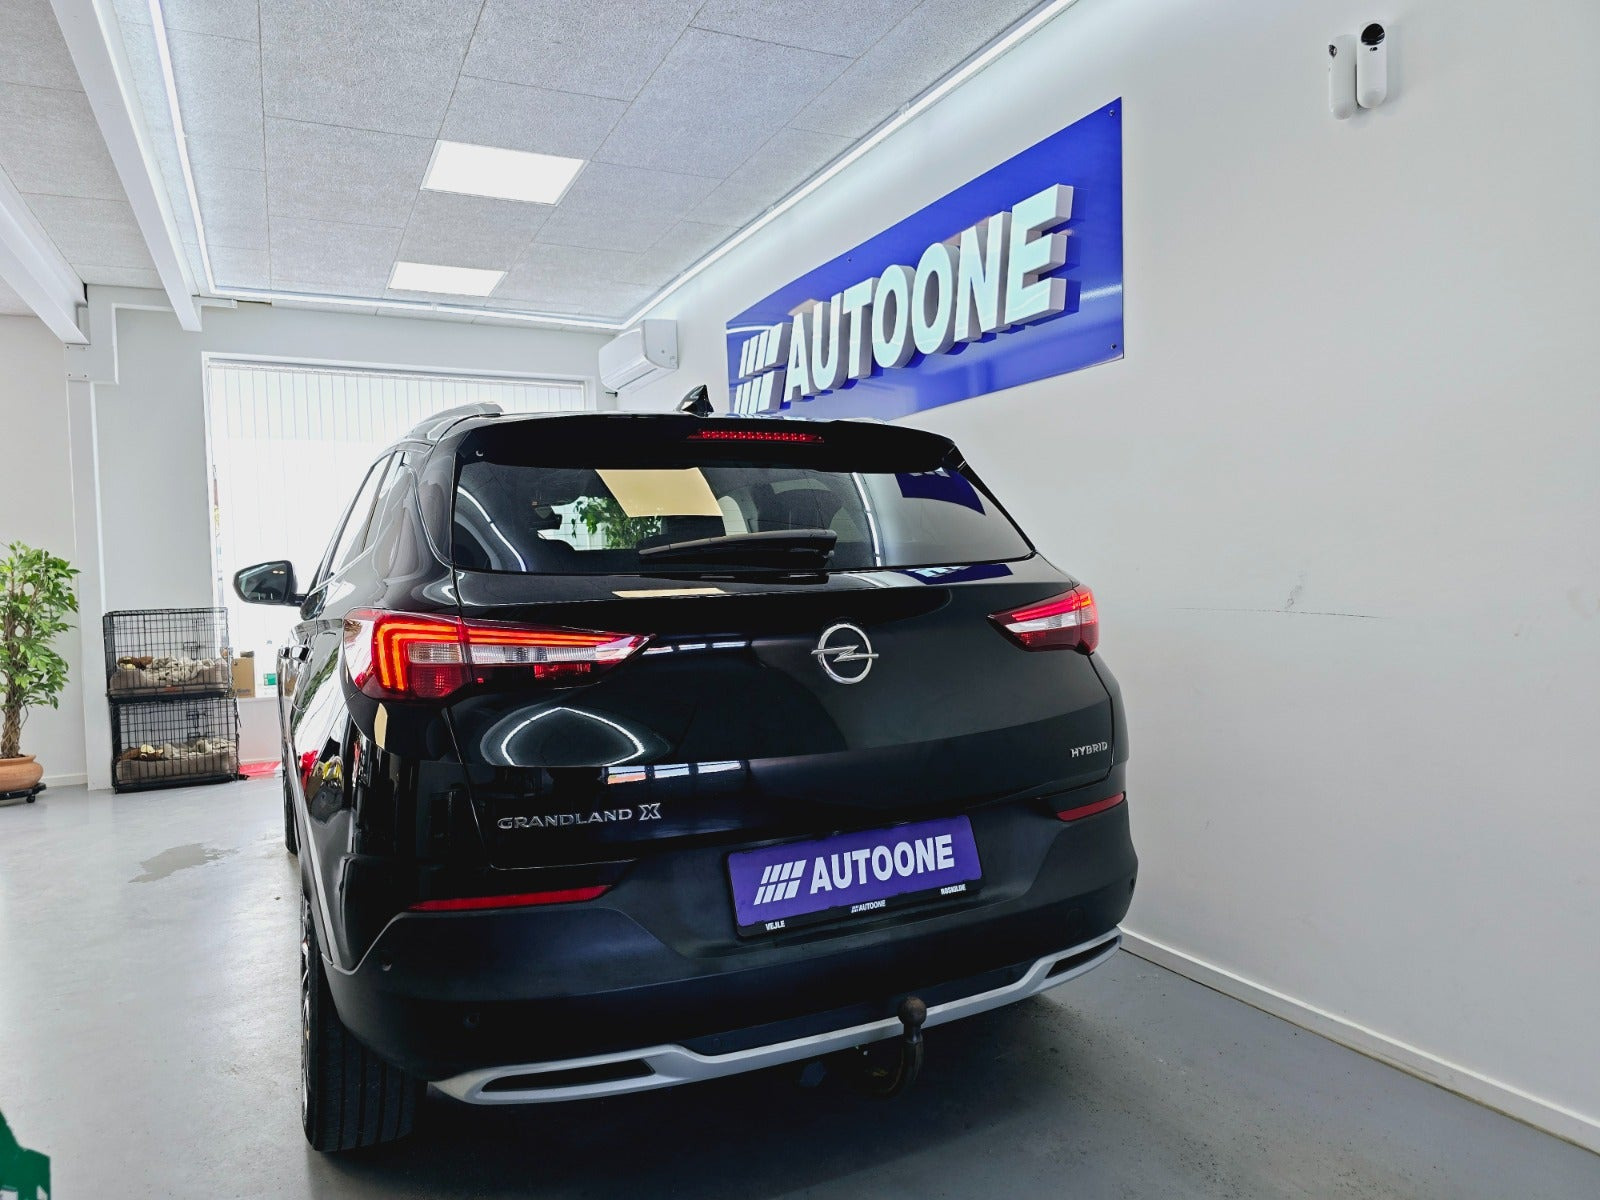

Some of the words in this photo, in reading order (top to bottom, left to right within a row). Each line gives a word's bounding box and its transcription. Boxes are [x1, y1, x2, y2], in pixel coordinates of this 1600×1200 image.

[784, 183, 1073, 402] AUTOONE
[1071, 741, 1108, 757] HYBRID
[497, 809, 633, 830] GRANDLAND
[638, 802, 662, 821] X
[810, 834, 955, 894] AUTOONE
[859, 899, 886, 911] AUTOONE
[765, 920, 785, 931] VEJLE
